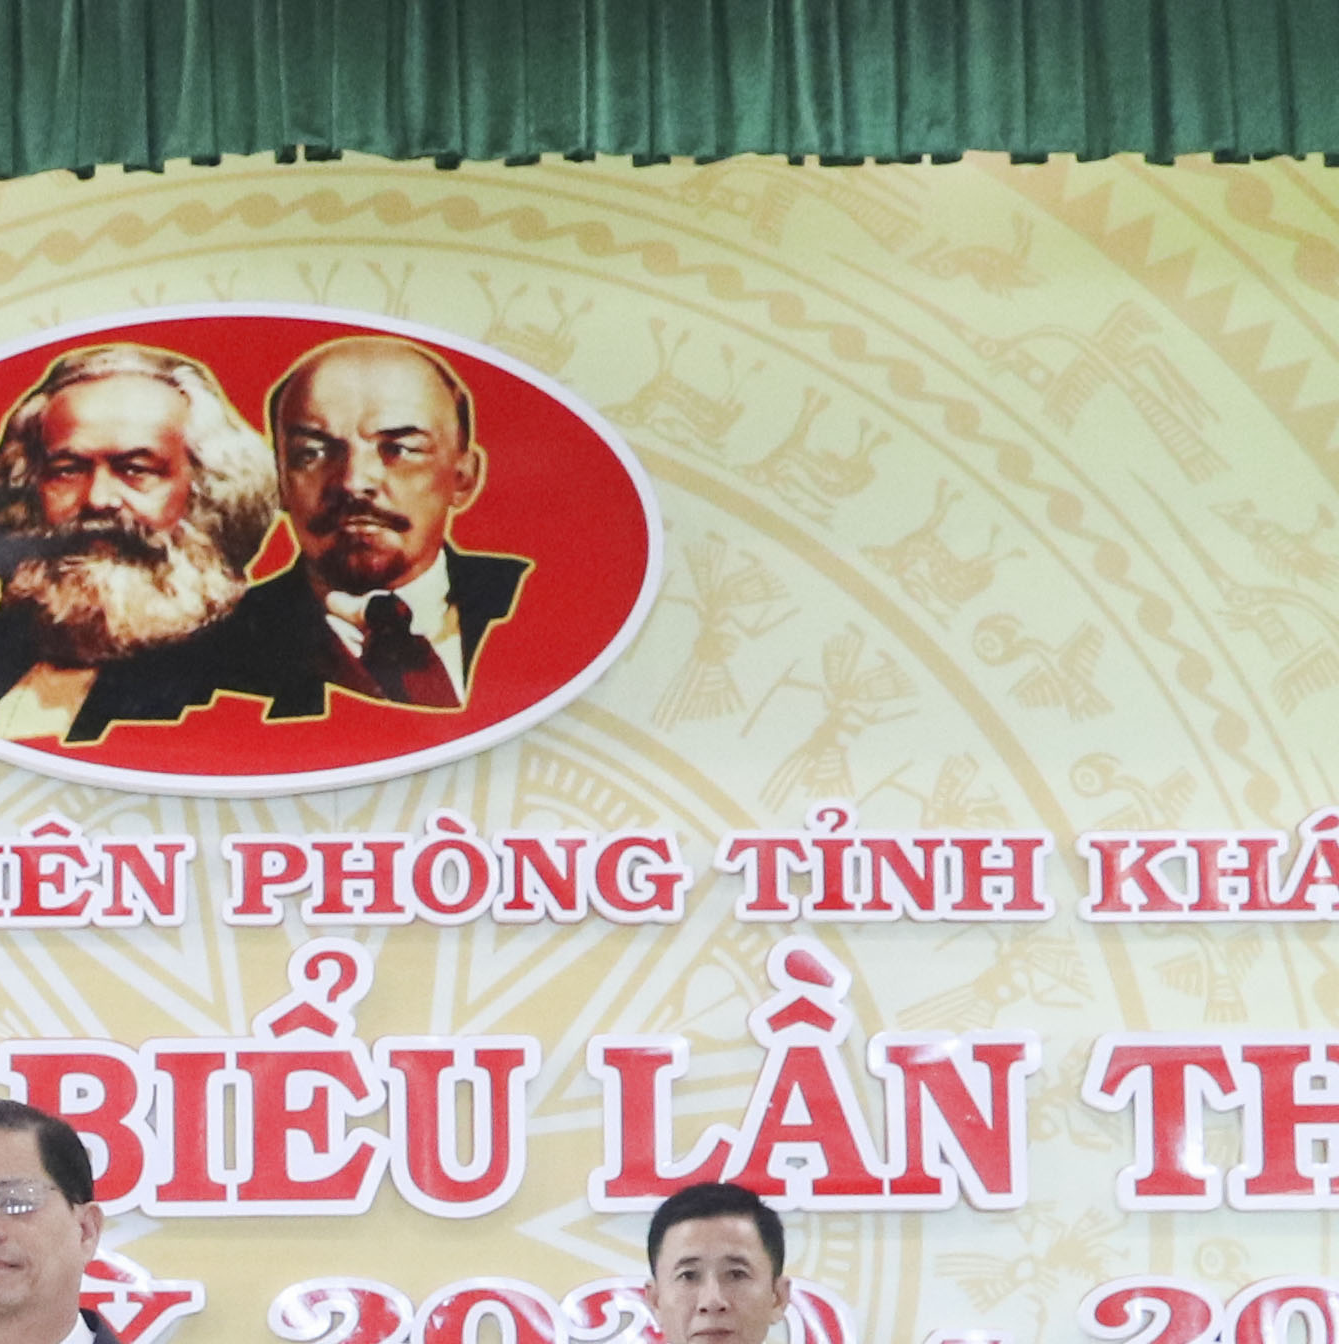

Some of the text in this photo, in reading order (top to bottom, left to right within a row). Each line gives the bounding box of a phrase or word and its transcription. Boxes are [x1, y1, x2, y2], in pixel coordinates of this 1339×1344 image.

[234, 815, 682, 915] PHÒNG
[728, 809, 1044, 912] TỈNH
[11, 951, 524, 1203] BIỂU
[604, 949, 1024, 1197] LẦN
